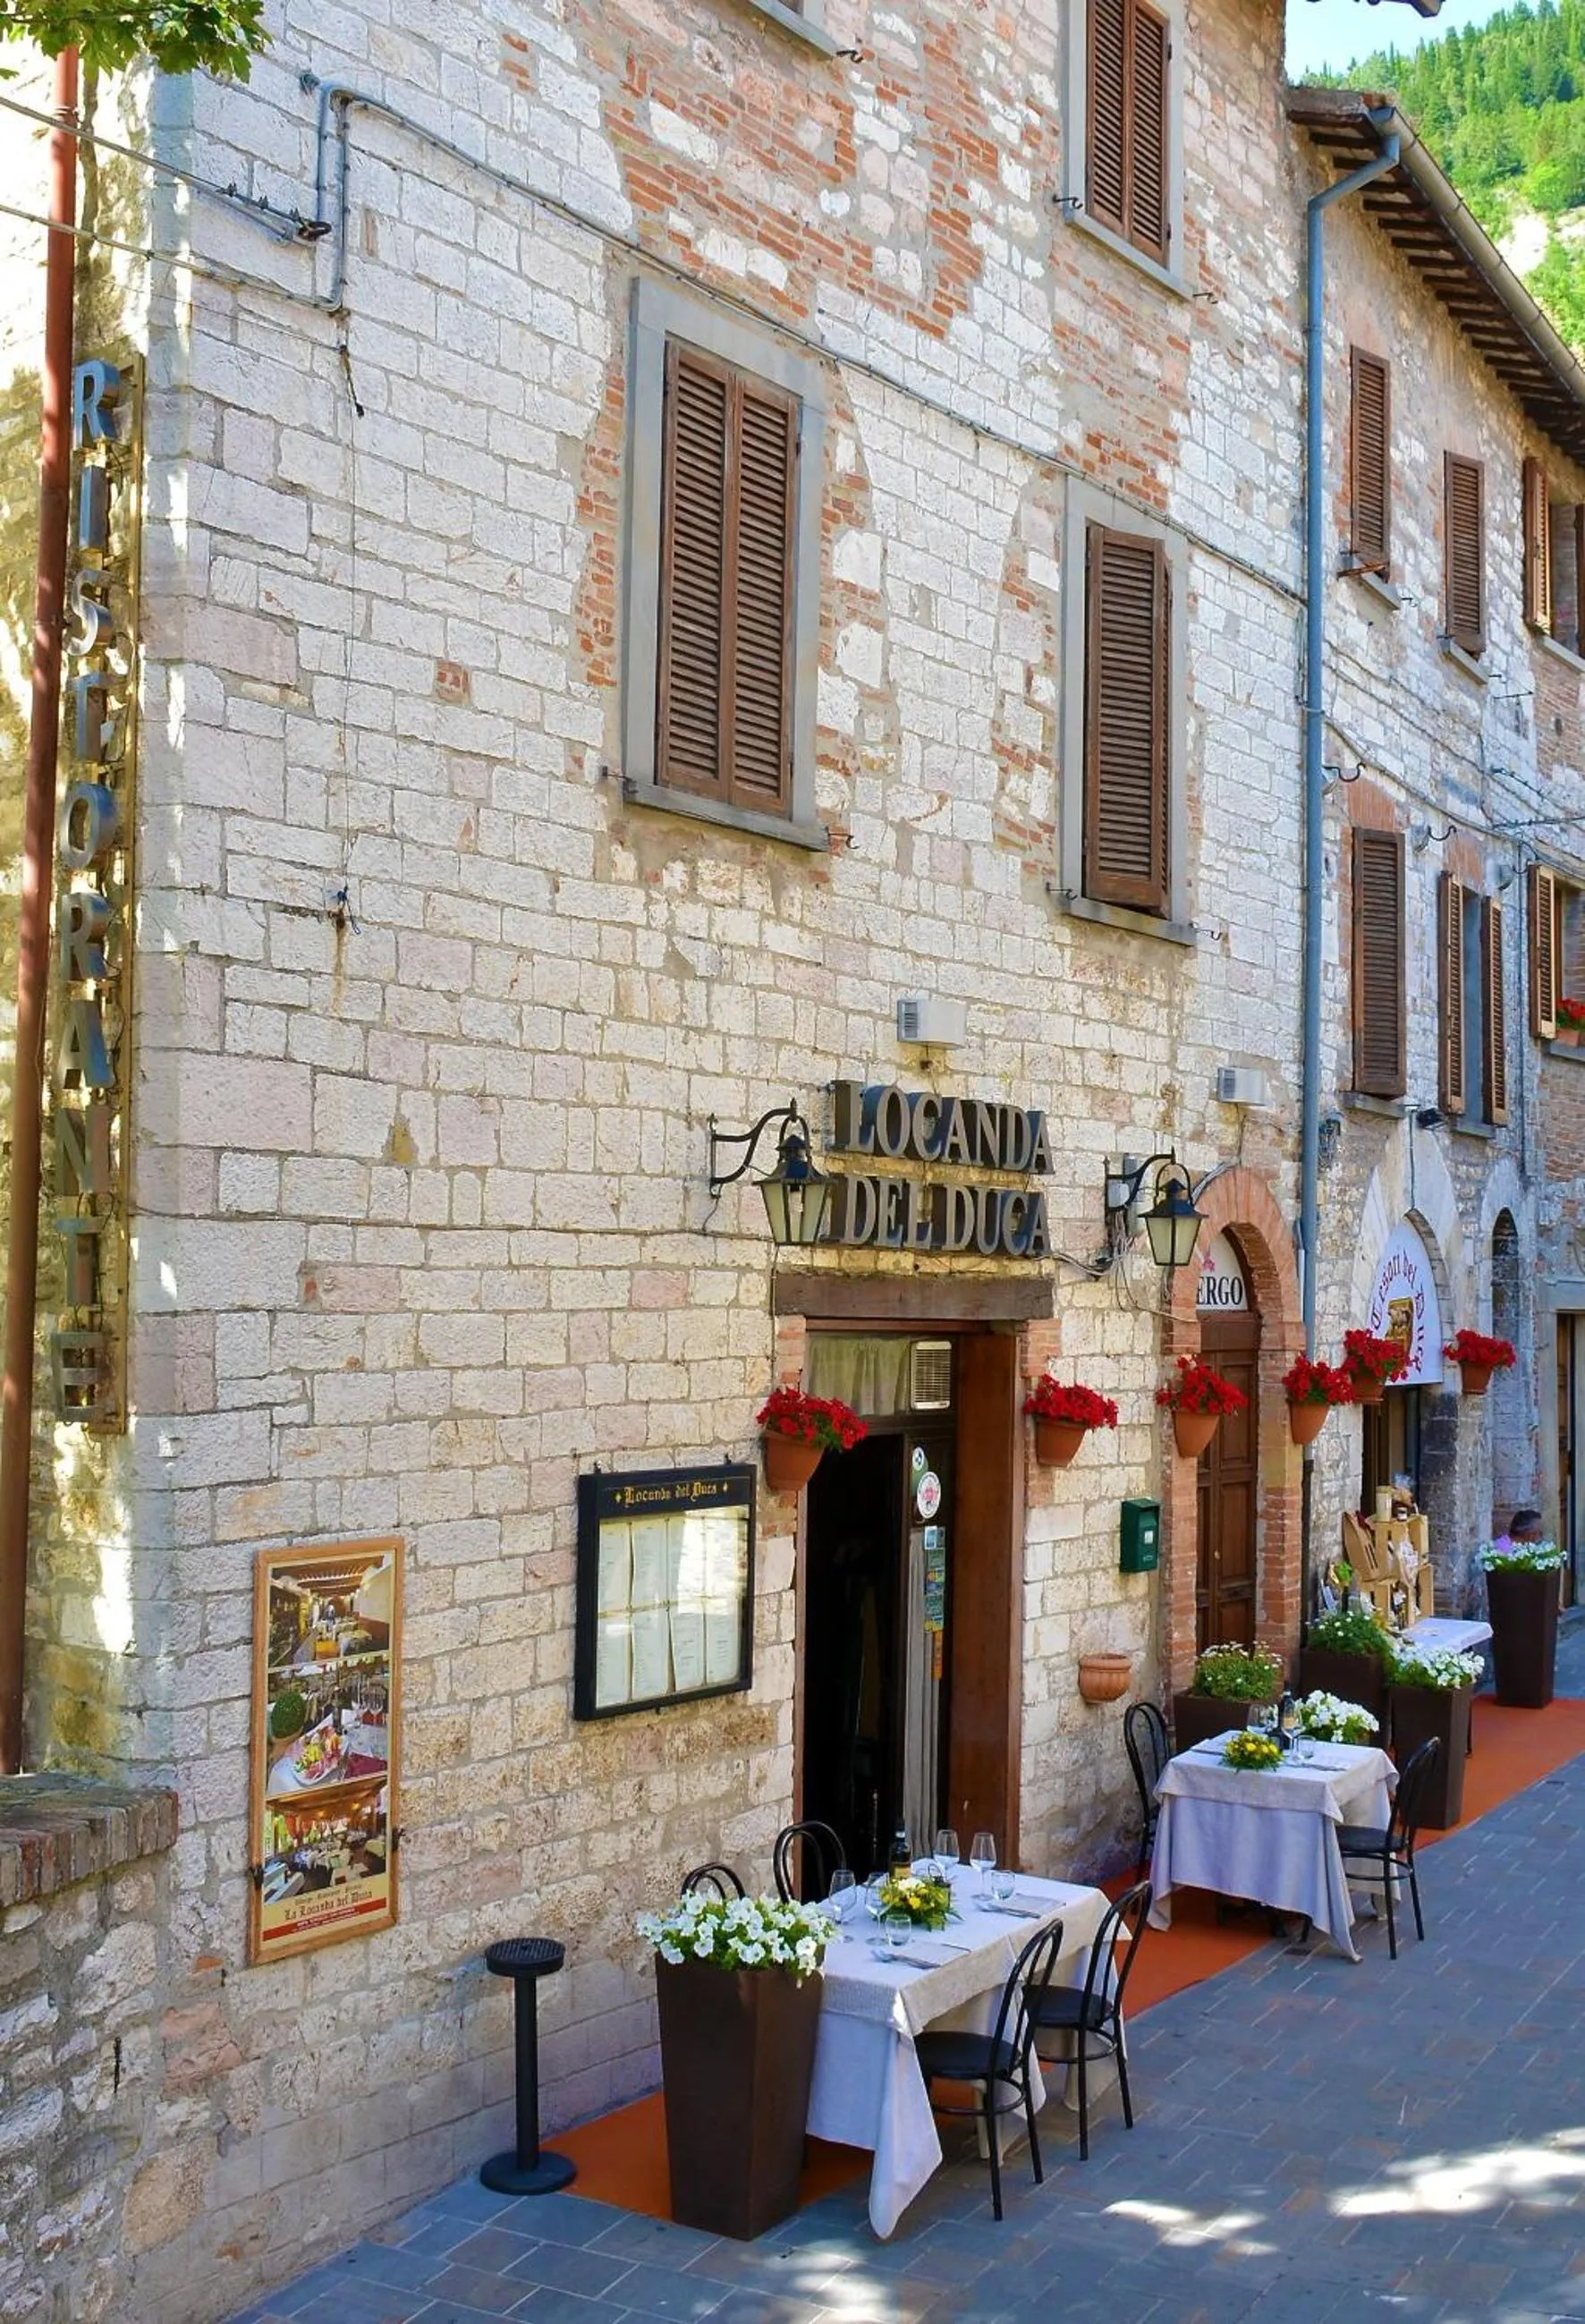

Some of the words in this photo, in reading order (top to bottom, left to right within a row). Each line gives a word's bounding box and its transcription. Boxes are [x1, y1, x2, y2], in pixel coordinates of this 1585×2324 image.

[50, 360, 119, 1424] RISTORANTE
[830, 1080, 1055, 1175] LOCANDA
[829, 1174, 933, 1251] DEL
[937, 1183, 1053, 1257] DUCA
[1196, 1276, 1243, 1305] ERGO
[623, 1486, 672, 1508] Locanda
[675, 1484, 691, 1498] del
[691, 1481, 716, 1502] Duca
